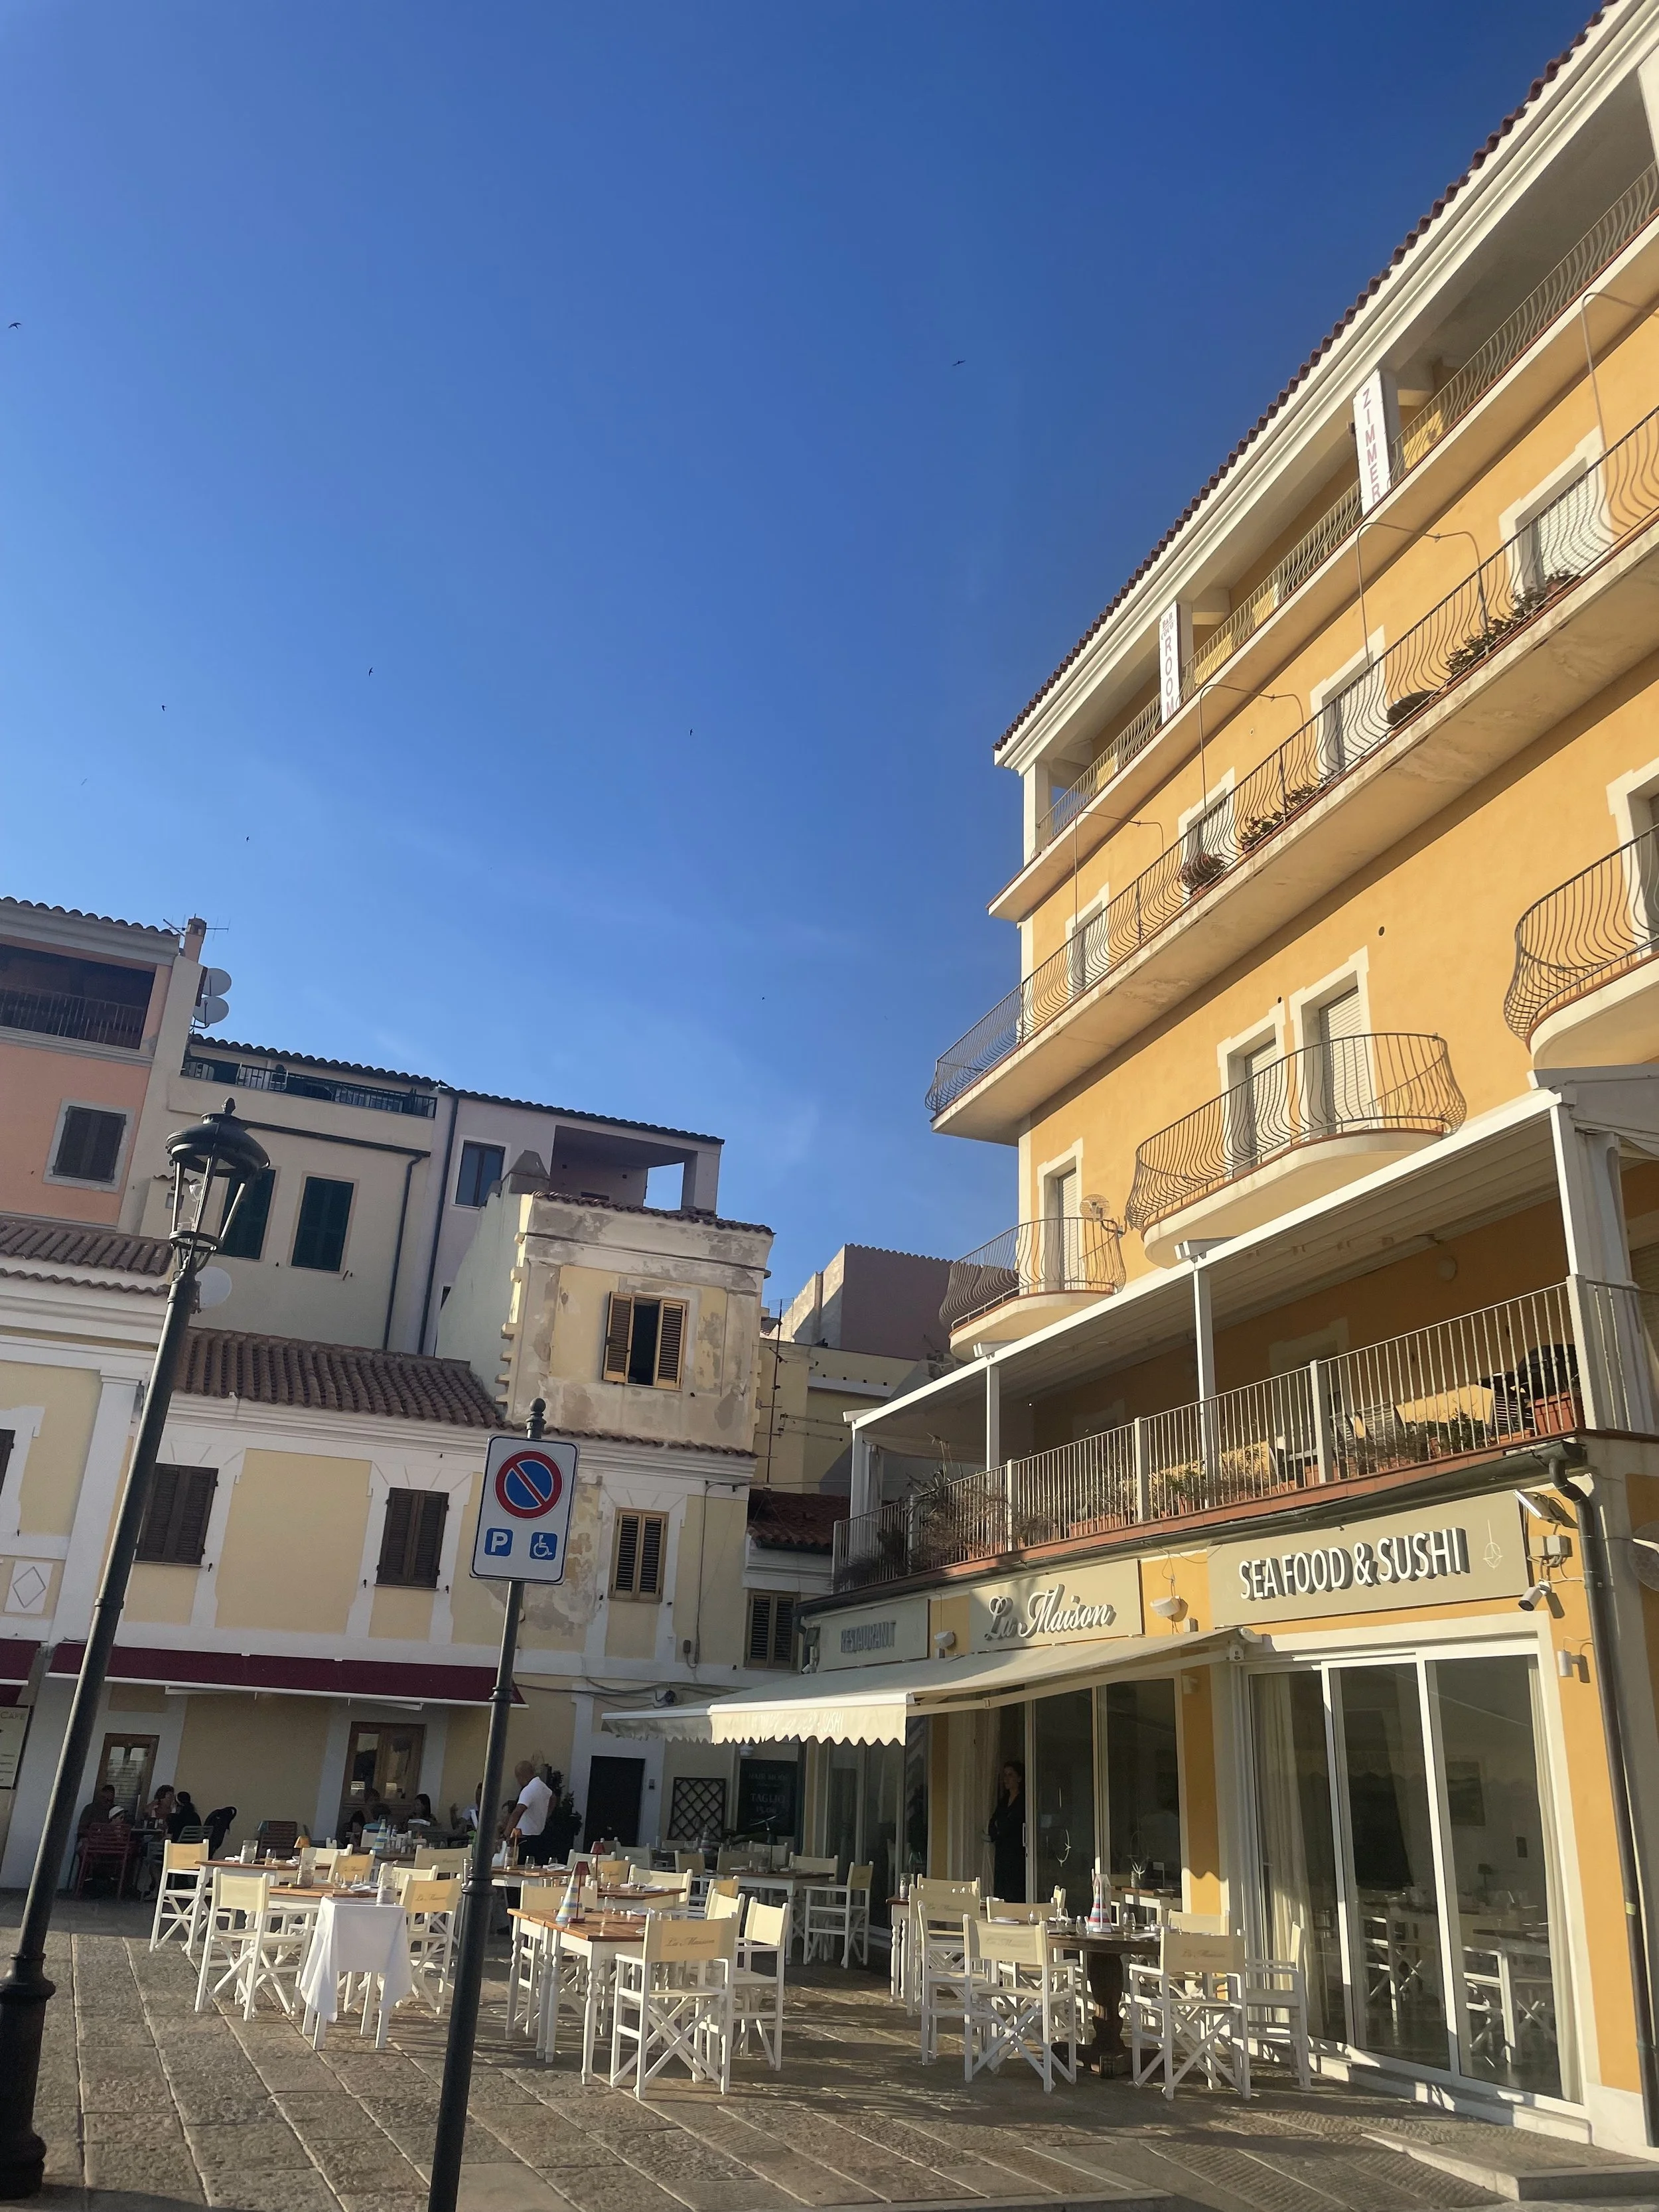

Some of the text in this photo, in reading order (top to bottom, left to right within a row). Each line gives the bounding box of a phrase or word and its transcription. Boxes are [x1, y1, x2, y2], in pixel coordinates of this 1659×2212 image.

[1362, 388, 1381, 504] ZIMMER
[491, 1531, 508, 1553] P
[1353, 1542, 1372, 1586] &
[1376, 1526, 1463, 1583] SUSHI
[985, 1584, 1112, 1640] La Maison
[841, 1621, 896, 1653] RESTAURANT
[750, 1793, 786, 1804] TAGLIO
